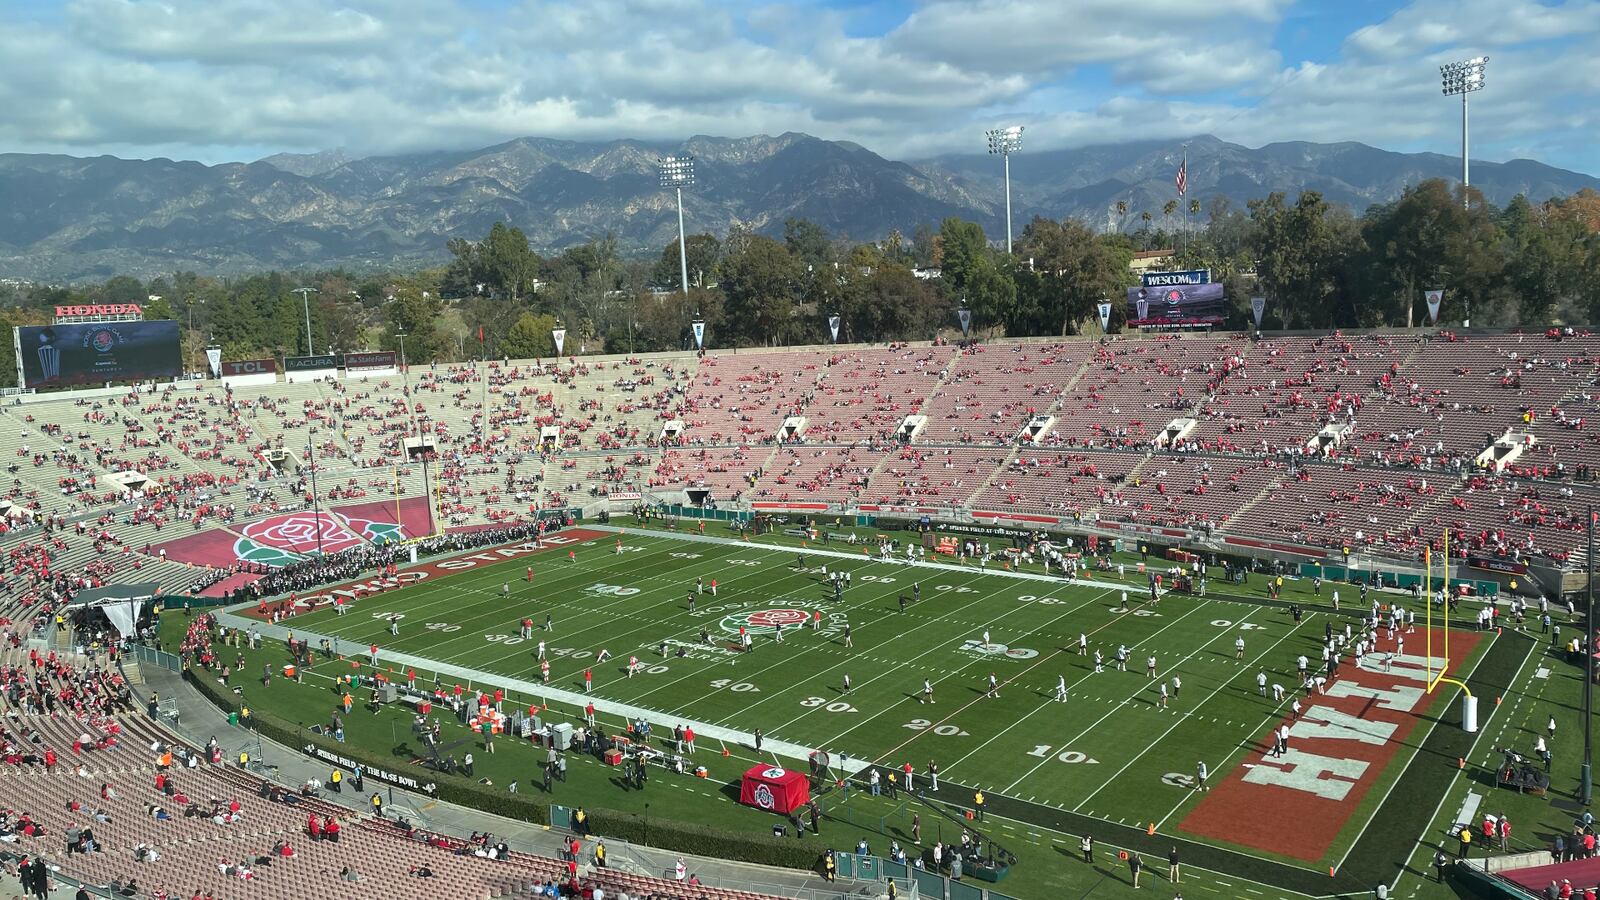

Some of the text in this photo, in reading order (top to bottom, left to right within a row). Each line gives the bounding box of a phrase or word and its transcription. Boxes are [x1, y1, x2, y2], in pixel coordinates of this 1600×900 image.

[1147, 275, 1189, 286] WESCOM
[54, 304, 143, 317] HONDA
[231, 362, 266, 373] TCL
[295, 358, 334, 367] ACURA
[435, 536, 579, 570] STATE
[1209, 619, 1259, 630] 10
[553, 648, 593, 659] 40
[710, 678, 754, 692] 40
[800, 696, 851, 713] 30
[902, 719, 960, 736] 20
[1241, 652, 1450, 801] UTAH
[1027, 744, 1087, 764] 10
[339, 757, 356, 769] FIELD
[366, 766, 380, 777] THE
[399, 776, 418, 788] BOWL
